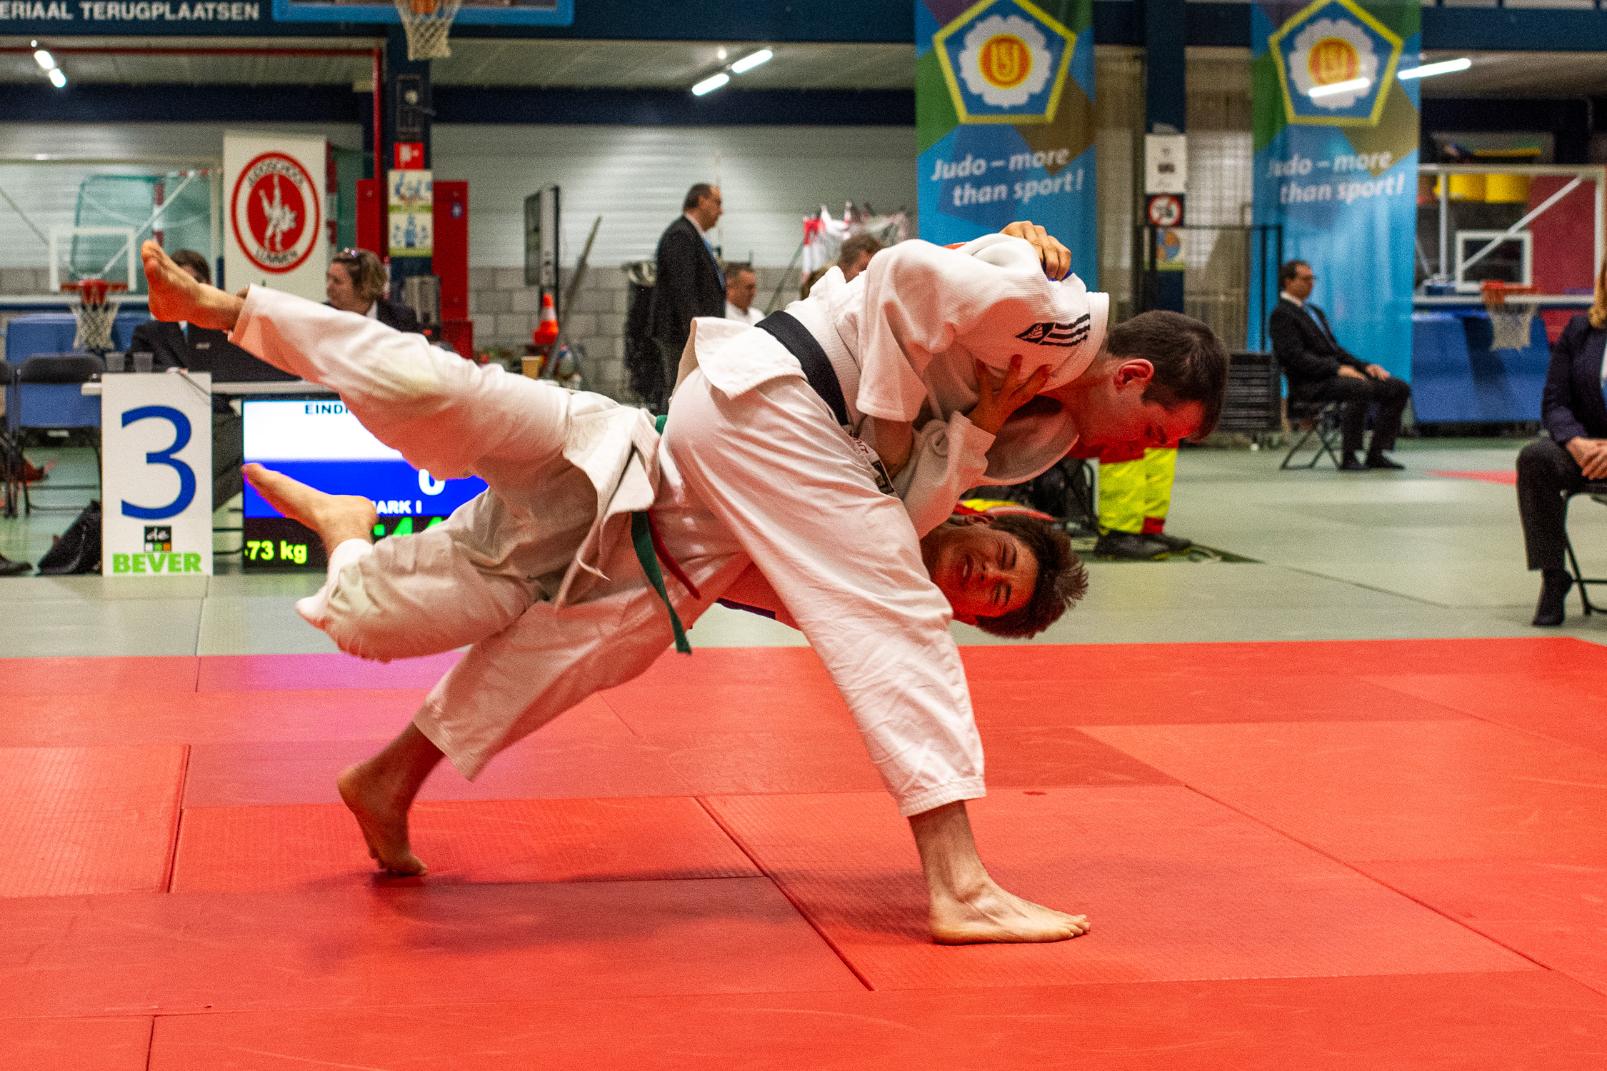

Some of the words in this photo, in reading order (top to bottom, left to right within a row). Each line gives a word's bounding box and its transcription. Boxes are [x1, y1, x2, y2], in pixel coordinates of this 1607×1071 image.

[79, 2, 260, 21] TERUGPLAATSEN
[931, 154, 986, 181] Judo
[1008, 148, 1070, 172] more
[1333, 151, 1393, 173] more
[952, 182, 1008, 207] than
[1013, 168, 1085, 204] sport!
[1280, 181, 1333, 204] than
[1338, 171, 1406, 204] sport!
[305, 404, 349, 415] EIND
[121, 405, 196, 520] 3
[146, 527, 169, 542] de
[112, 552, 202, 573] BEVER
[280, 540, 307, 564] kg
